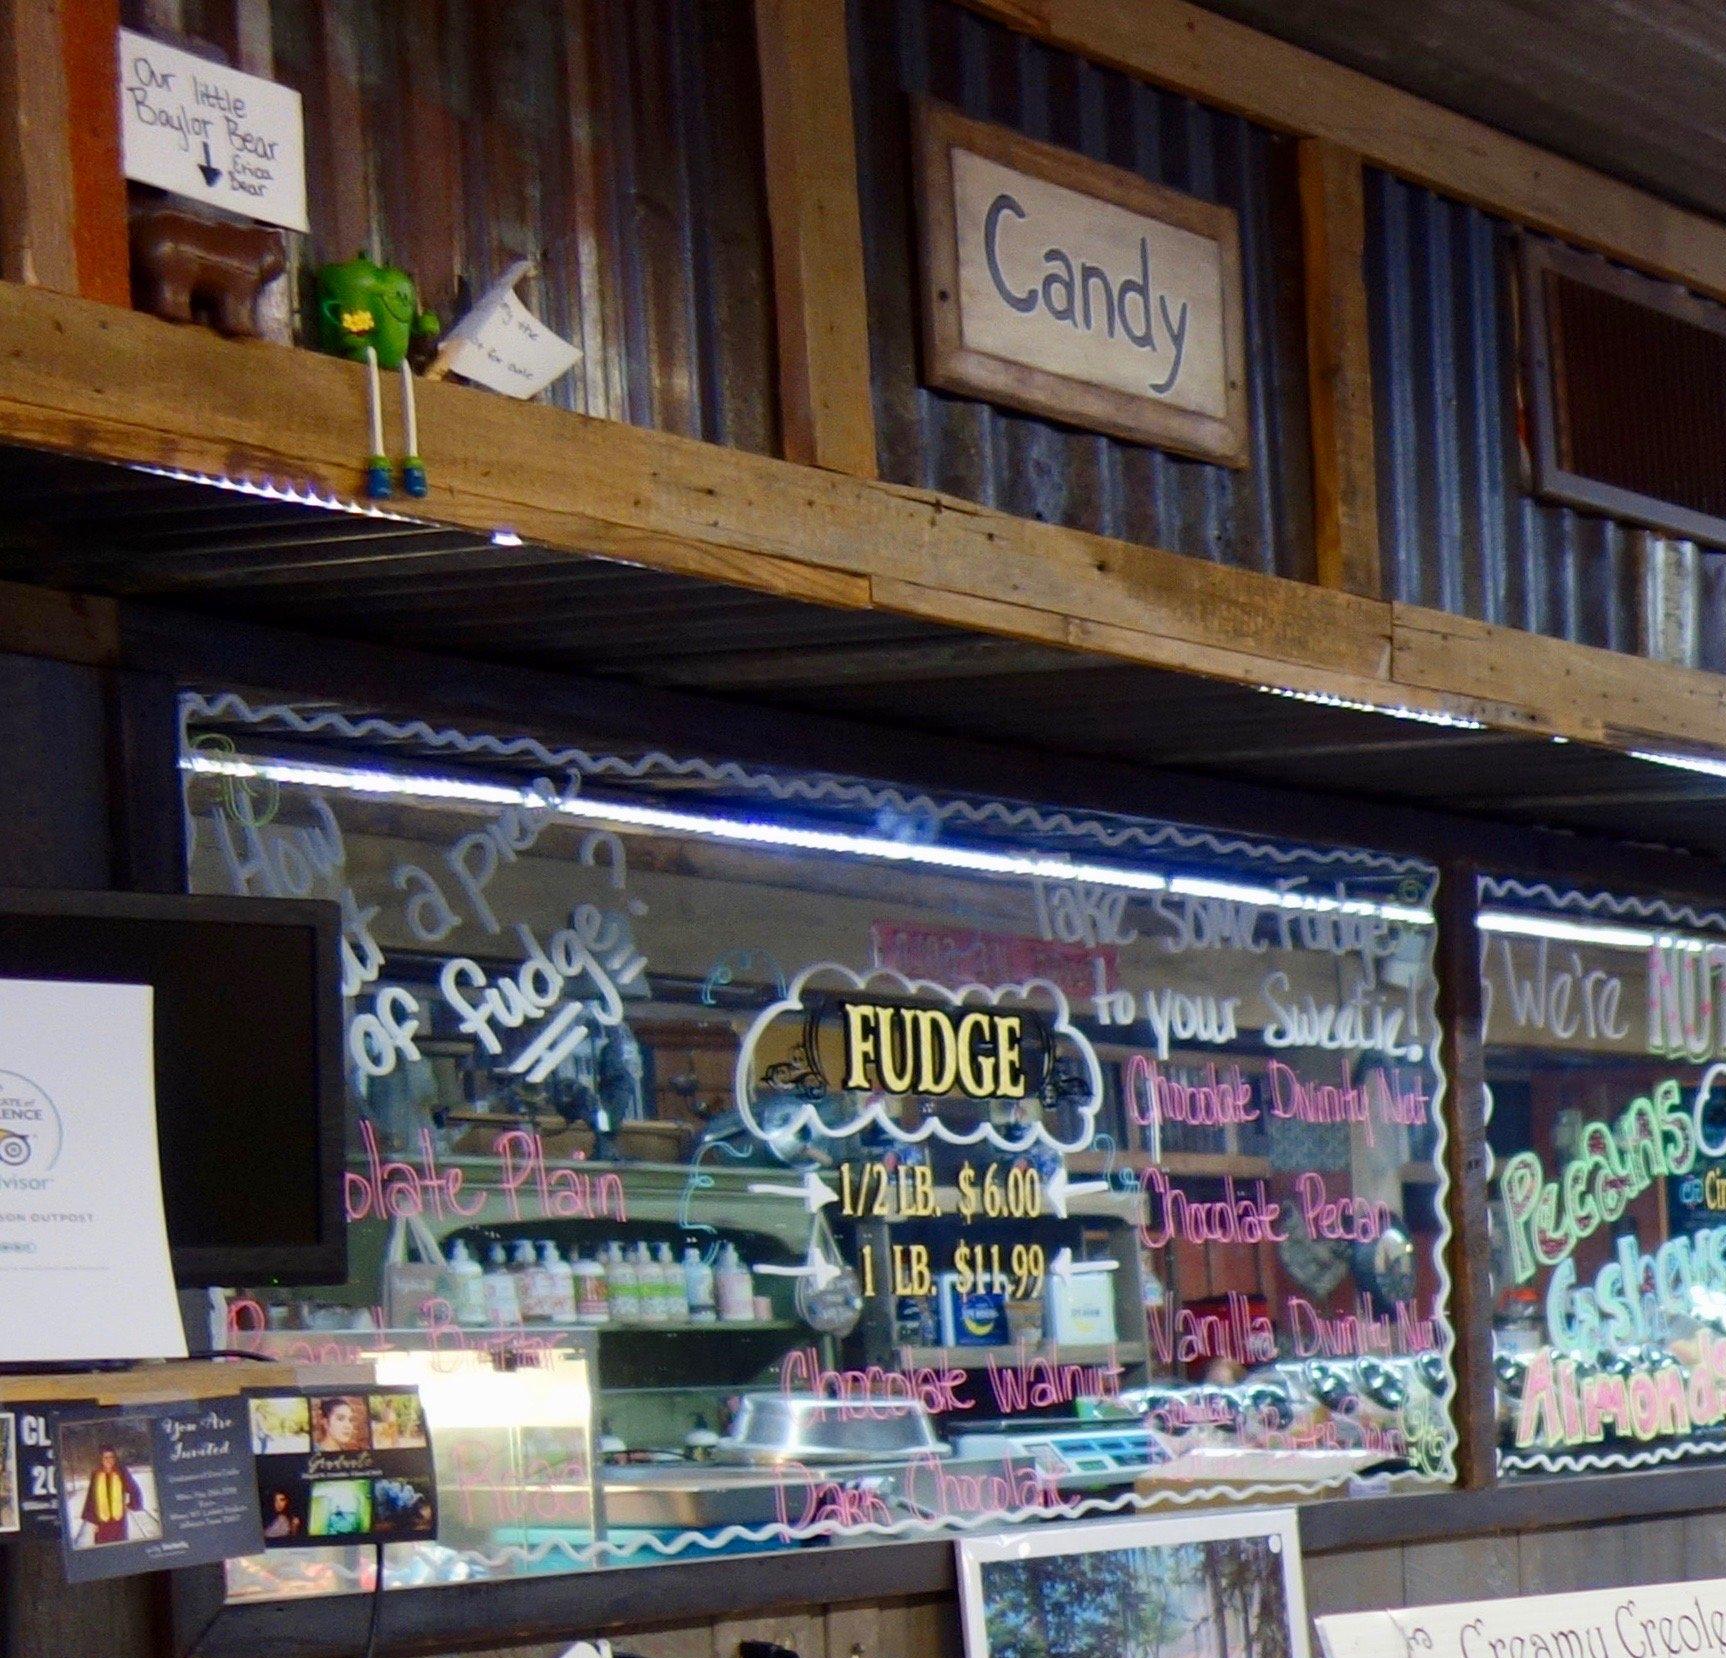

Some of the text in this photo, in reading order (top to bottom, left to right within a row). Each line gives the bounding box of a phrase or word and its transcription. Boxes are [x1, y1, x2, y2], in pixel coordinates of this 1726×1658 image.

[127, 86, 279, 161] Baylor Bear
[134, 58, 247, 119] Our little
[984, 193, 1188, 394] Candy
[349, 975, 422, 1076] of
[1144, 988, 1242, 1061] your
[1500, 938, 1629, 1041] We're
[845, 1002, 1027, 1100] FUDGE
[1123, 1054, 1260, 1126] Chocolate
[492, 1130, 628, 1224] Plain
[838, 1165, 887, 1218] 1/2
[896, 1167, 942, 1217] LB.
[1136, 1165, 1392, 1250] Chocolate Pecan
[1500, 1078, 1700, 1286] Pecans
[860, 1241, 1047, 1300] 1 LB. $11.99
[1145, 1290, 1280, 1364] Vanilla
[780, 1336, 1127, 1426] Chocolate Walnut
[162, 1411, 235, 1442] You Are
